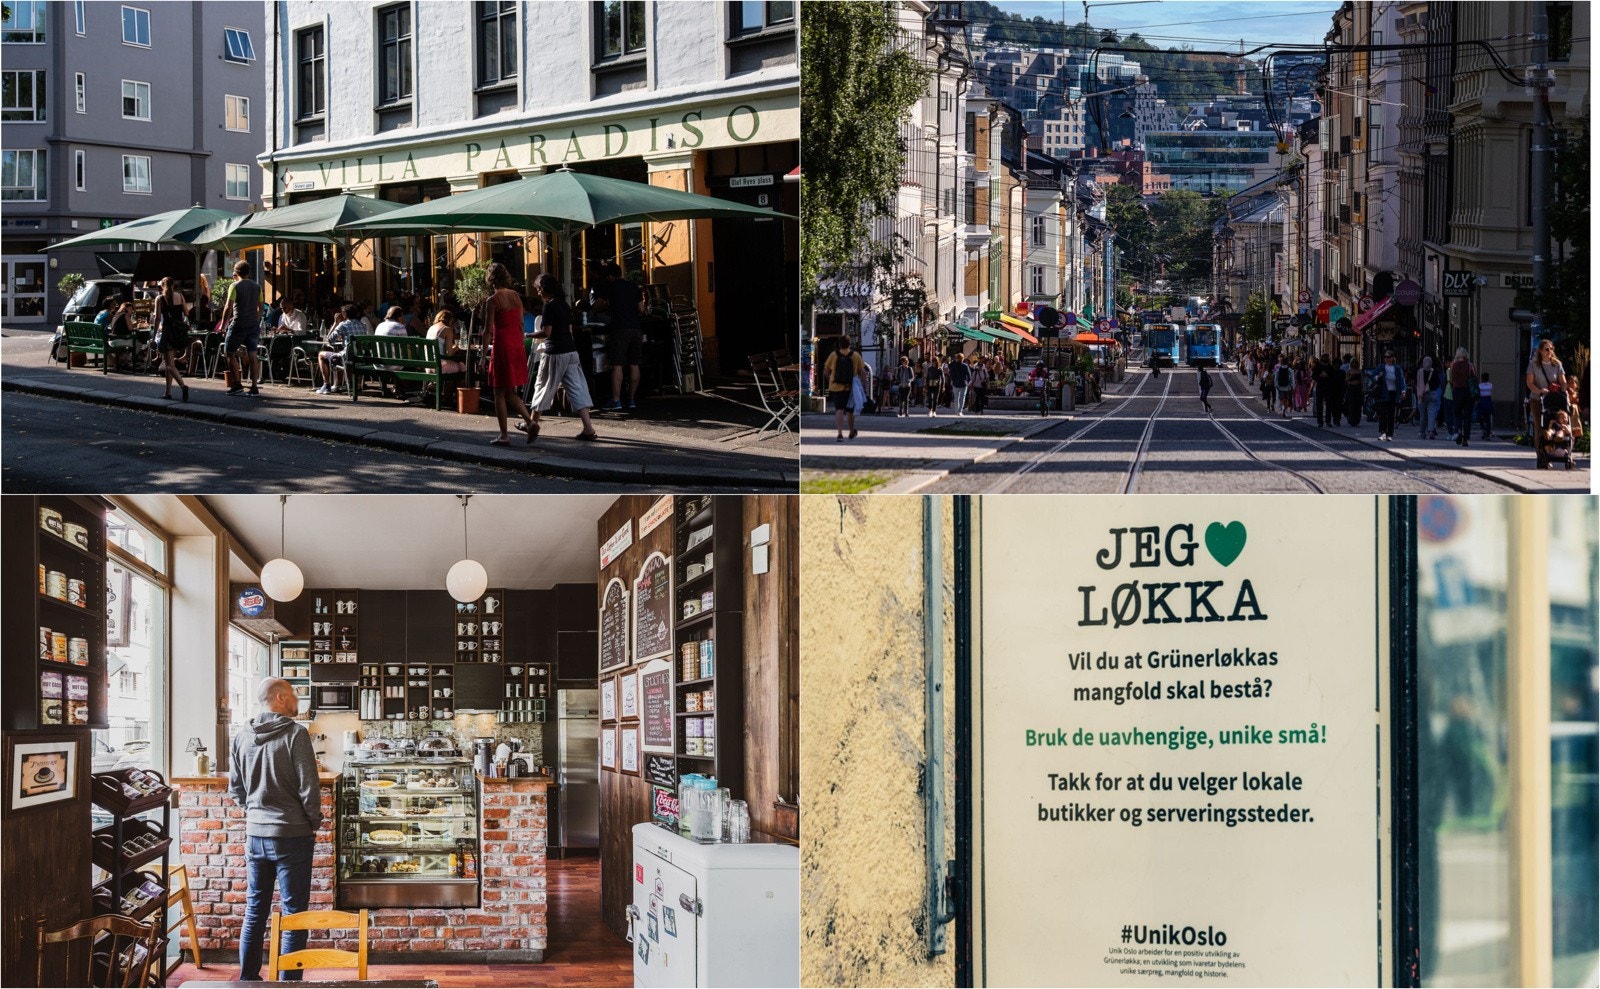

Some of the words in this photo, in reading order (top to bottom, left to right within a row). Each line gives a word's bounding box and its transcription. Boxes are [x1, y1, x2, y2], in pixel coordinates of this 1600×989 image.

[318, 151, 420, 187] VILLA
[465, 104, 761, 173] PARADISO
[731, 178, 742, 186] Olaf
[743, 177, 755, 187] Ryes
[757, 176, 772, 186] plass
[760, 195, 766, 204] 8
[1444, 273, 1470, 289] DLX
[1095, 523, 1200, 571] JEG
[1077, 578, 1269, 629] LØKKA
[1068, 651, 1091, 671] Vil
[1096, 651, 1119, 671] du
[1124, 652, 1143, 670] at
[1147, 646, 1279, 670] Grünerløkkas
[1073, 680, 1162, 706] mangfold
[1166, 679, 1206, 700] skal
[1210, 676, 1273, 700] bestå?
[1025, 727, 1068, 747] Bruk
[1072, 727, 1095, 747] de
[1098, 725, 1215, 751] uavhengige,
[1219, 724, 1274, 746] unike
[1278, 722, 1327, 746] små!
[1047, 772, 1091, 792] Takk
[1095, 771, 1123, 791] for
[1127, 773, 1145, 792] at
[1149, 771, 1173, 792] du
[1177, 771, 1239, 797] velger
[1243, 771, 1303, 792] lokale
[1038, 802, 1116, 822] butikker
[1120, 807, 1143, 828] og
[1146, 802, 1315, 828] serveringssteder.
[1121, 923, 1228, 947] #UnikOslo
[1108, 947, 1122, 955] Unik
[1123, 947, 1137, 955] Oslo
[1138, 948, 1163, 956] arbeider
[1183, 949, 1203, 957] positiv
[1205, 950, 1231, 959] utvikling
[1152, 958, 1178, 967] utvikling
[1217, 960, 1246, 969] bydelens
[1138, 969, 1164, 977] særpreg,
[1165, 968, 1194, 977] mangfold
[1204, 970, 1229, 978] historie.
